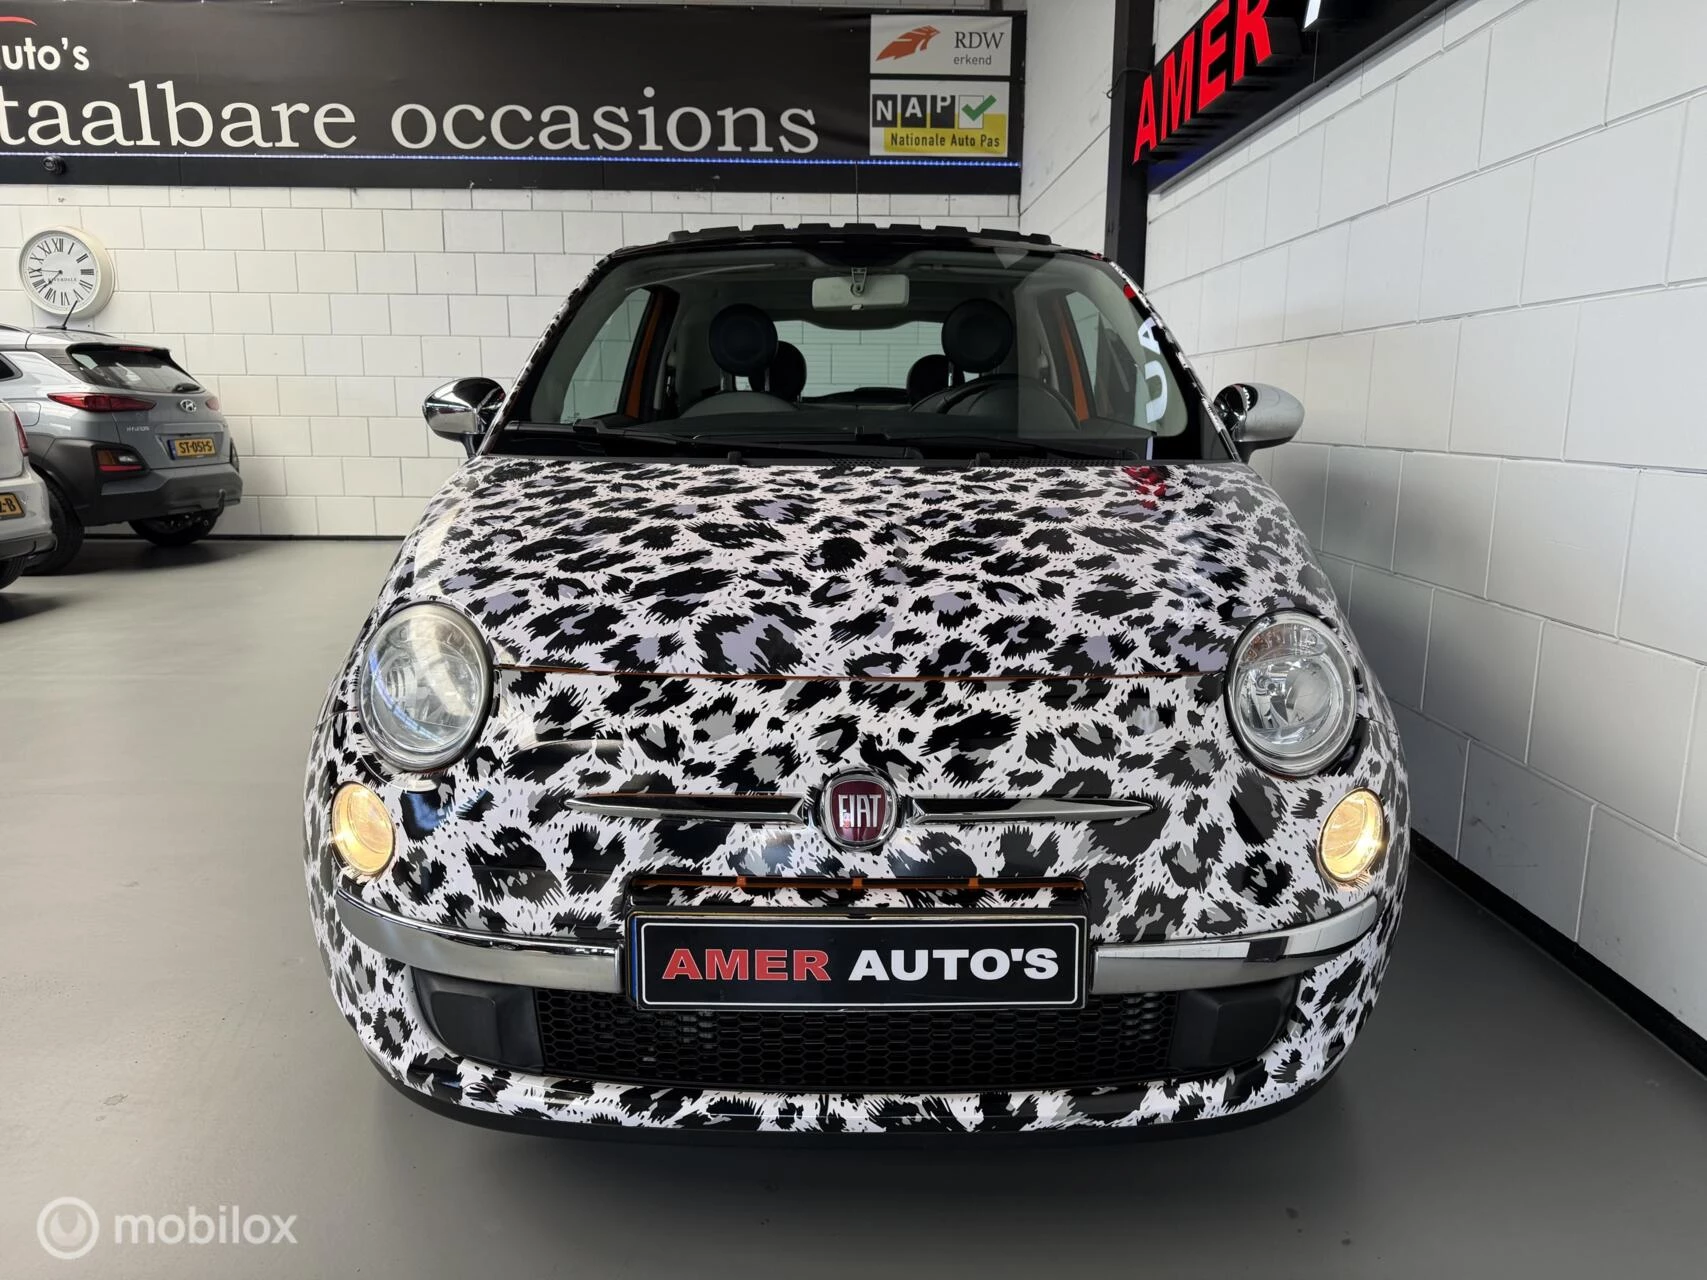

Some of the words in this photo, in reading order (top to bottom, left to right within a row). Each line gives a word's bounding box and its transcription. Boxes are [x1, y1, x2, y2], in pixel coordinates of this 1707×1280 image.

[0, 37, 90, 71] uto's
[954, 31, 1004, 49] RDW
[953, 54, 992, 66] erkend
[1132, 0, 1273, 165] AMER
[0, 80, 357, 149] taalbare
[391, 86, 819, 154] occasions
[890, 133, 946, 147] Nationale
[950, 134, 976, 147] Auto
[980, 134, 1000, 147] Pas
[838, 794, 881, 828] FIAT
[662, 948, 832, 981] AMER
[848, 947, 1060, 982] AUTO'S
